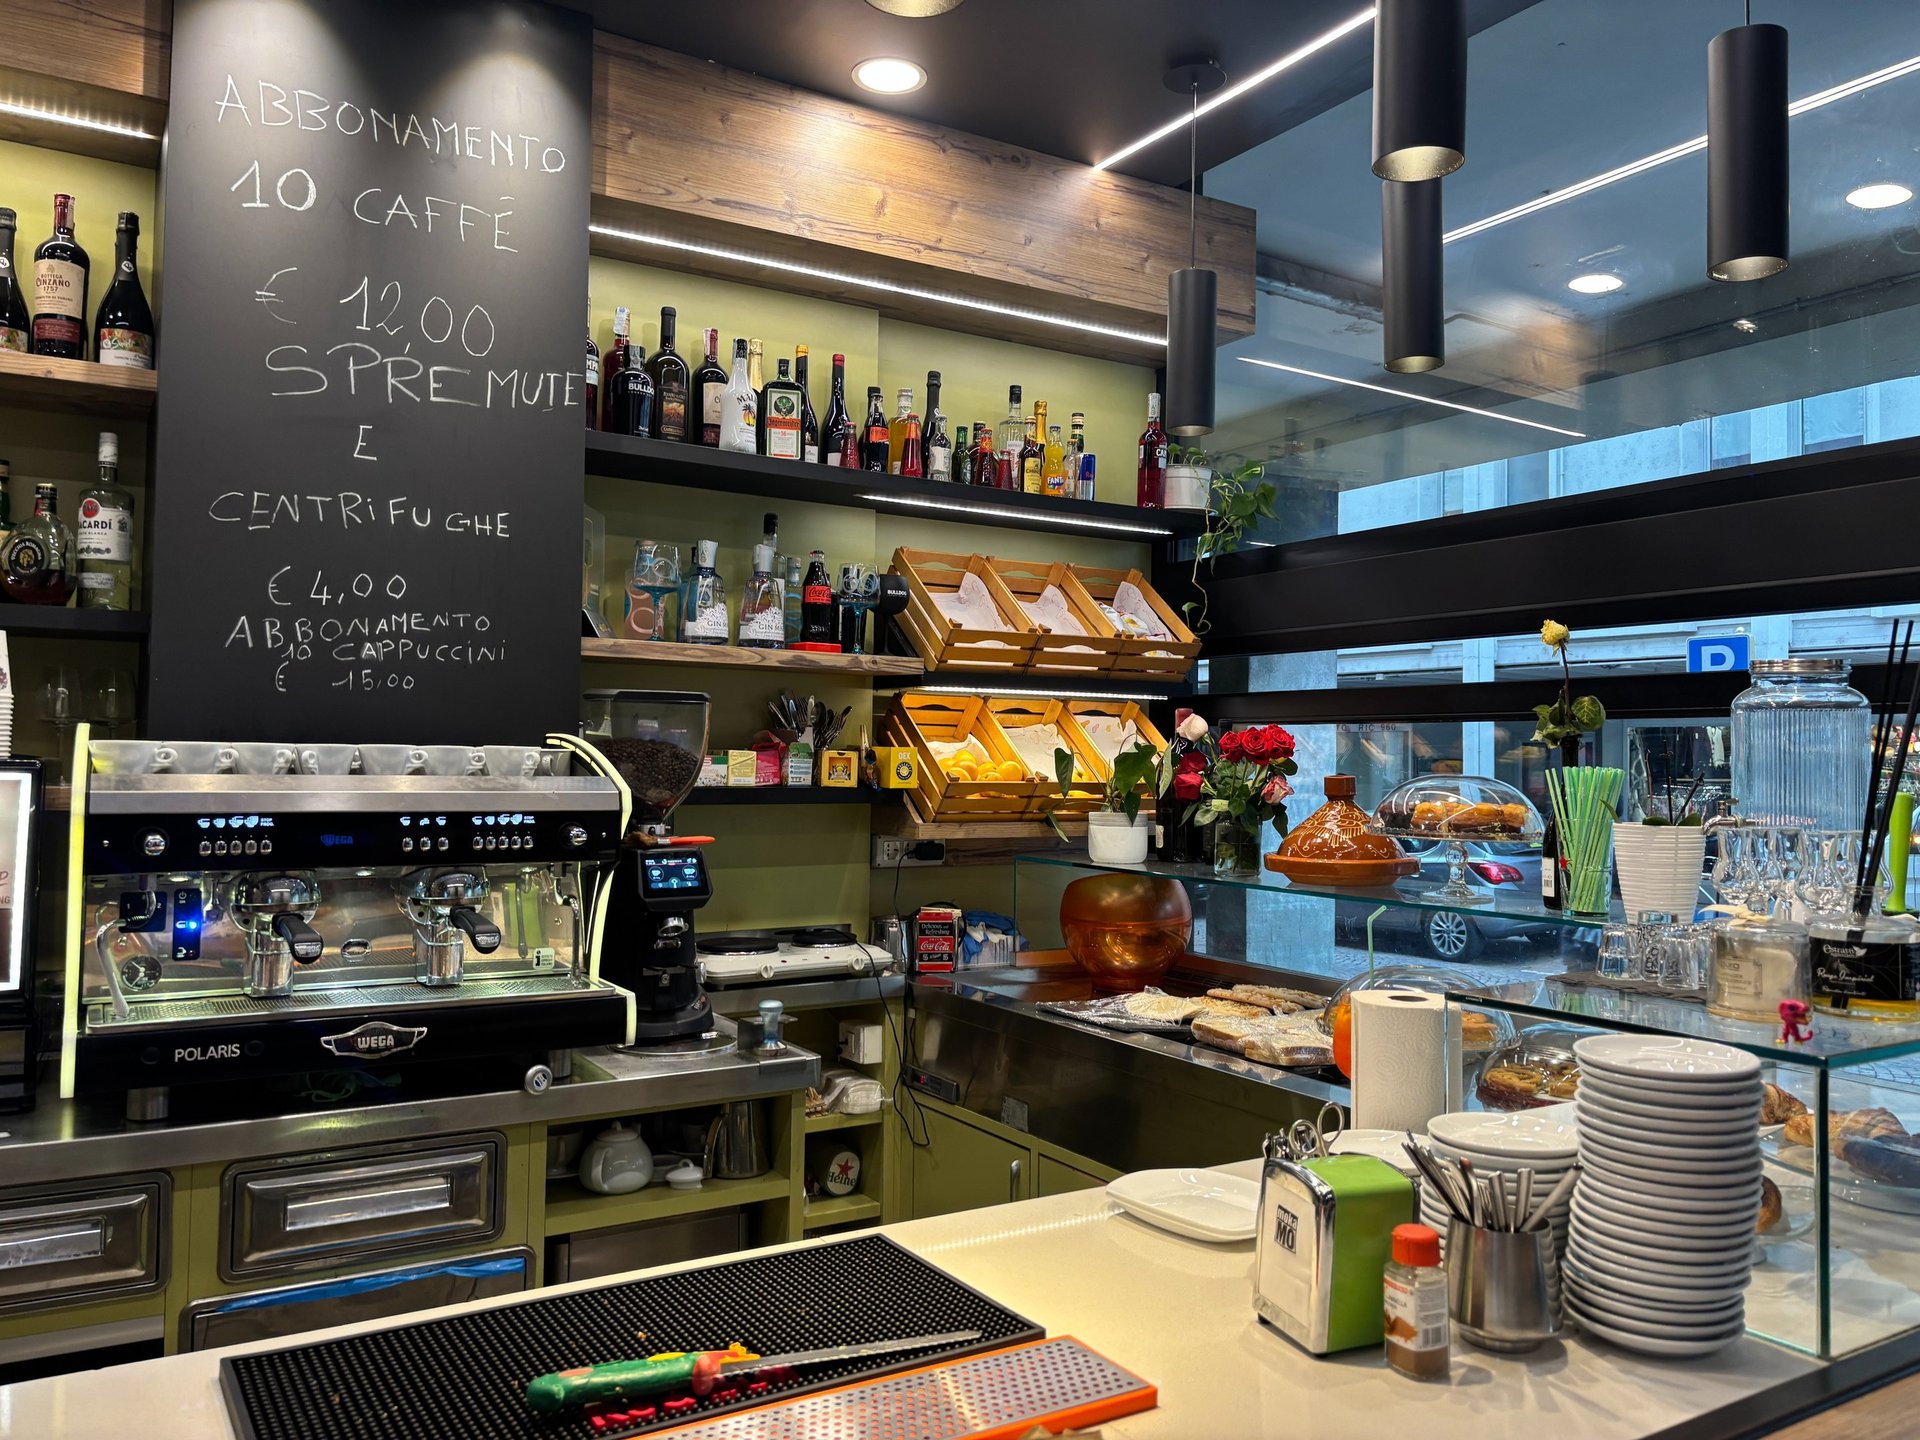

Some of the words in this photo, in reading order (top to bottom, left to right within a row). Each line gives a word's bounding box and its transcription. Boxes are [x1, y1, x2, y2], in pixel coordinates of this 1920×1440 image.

[216, 75, 566, 173] ABBONAMENTO
[231, 160, 317, 211] 10
[36, 277, 71, 289] CINZANO
[255, 267, 298, 324] €
[354, 425, 377, 461] E
[269, 566, 291, 605] €
[311, 570, 406, 605] 4,00
[225, 613, 490, 648] ABBONAMENTO
[758, 623, 773, 631] GIN
[282, 642, 312, 660] 10
[1701, 645, 1735, 672] P
[275, 662, 288, 691] €
[174, 1043, 241, 1063] POLARIS
[357, 1034, 395, 1049] WEGA
[1277, 1207, 1298, 1230] moka
[1275, 1219, 1296, 1251] MO
